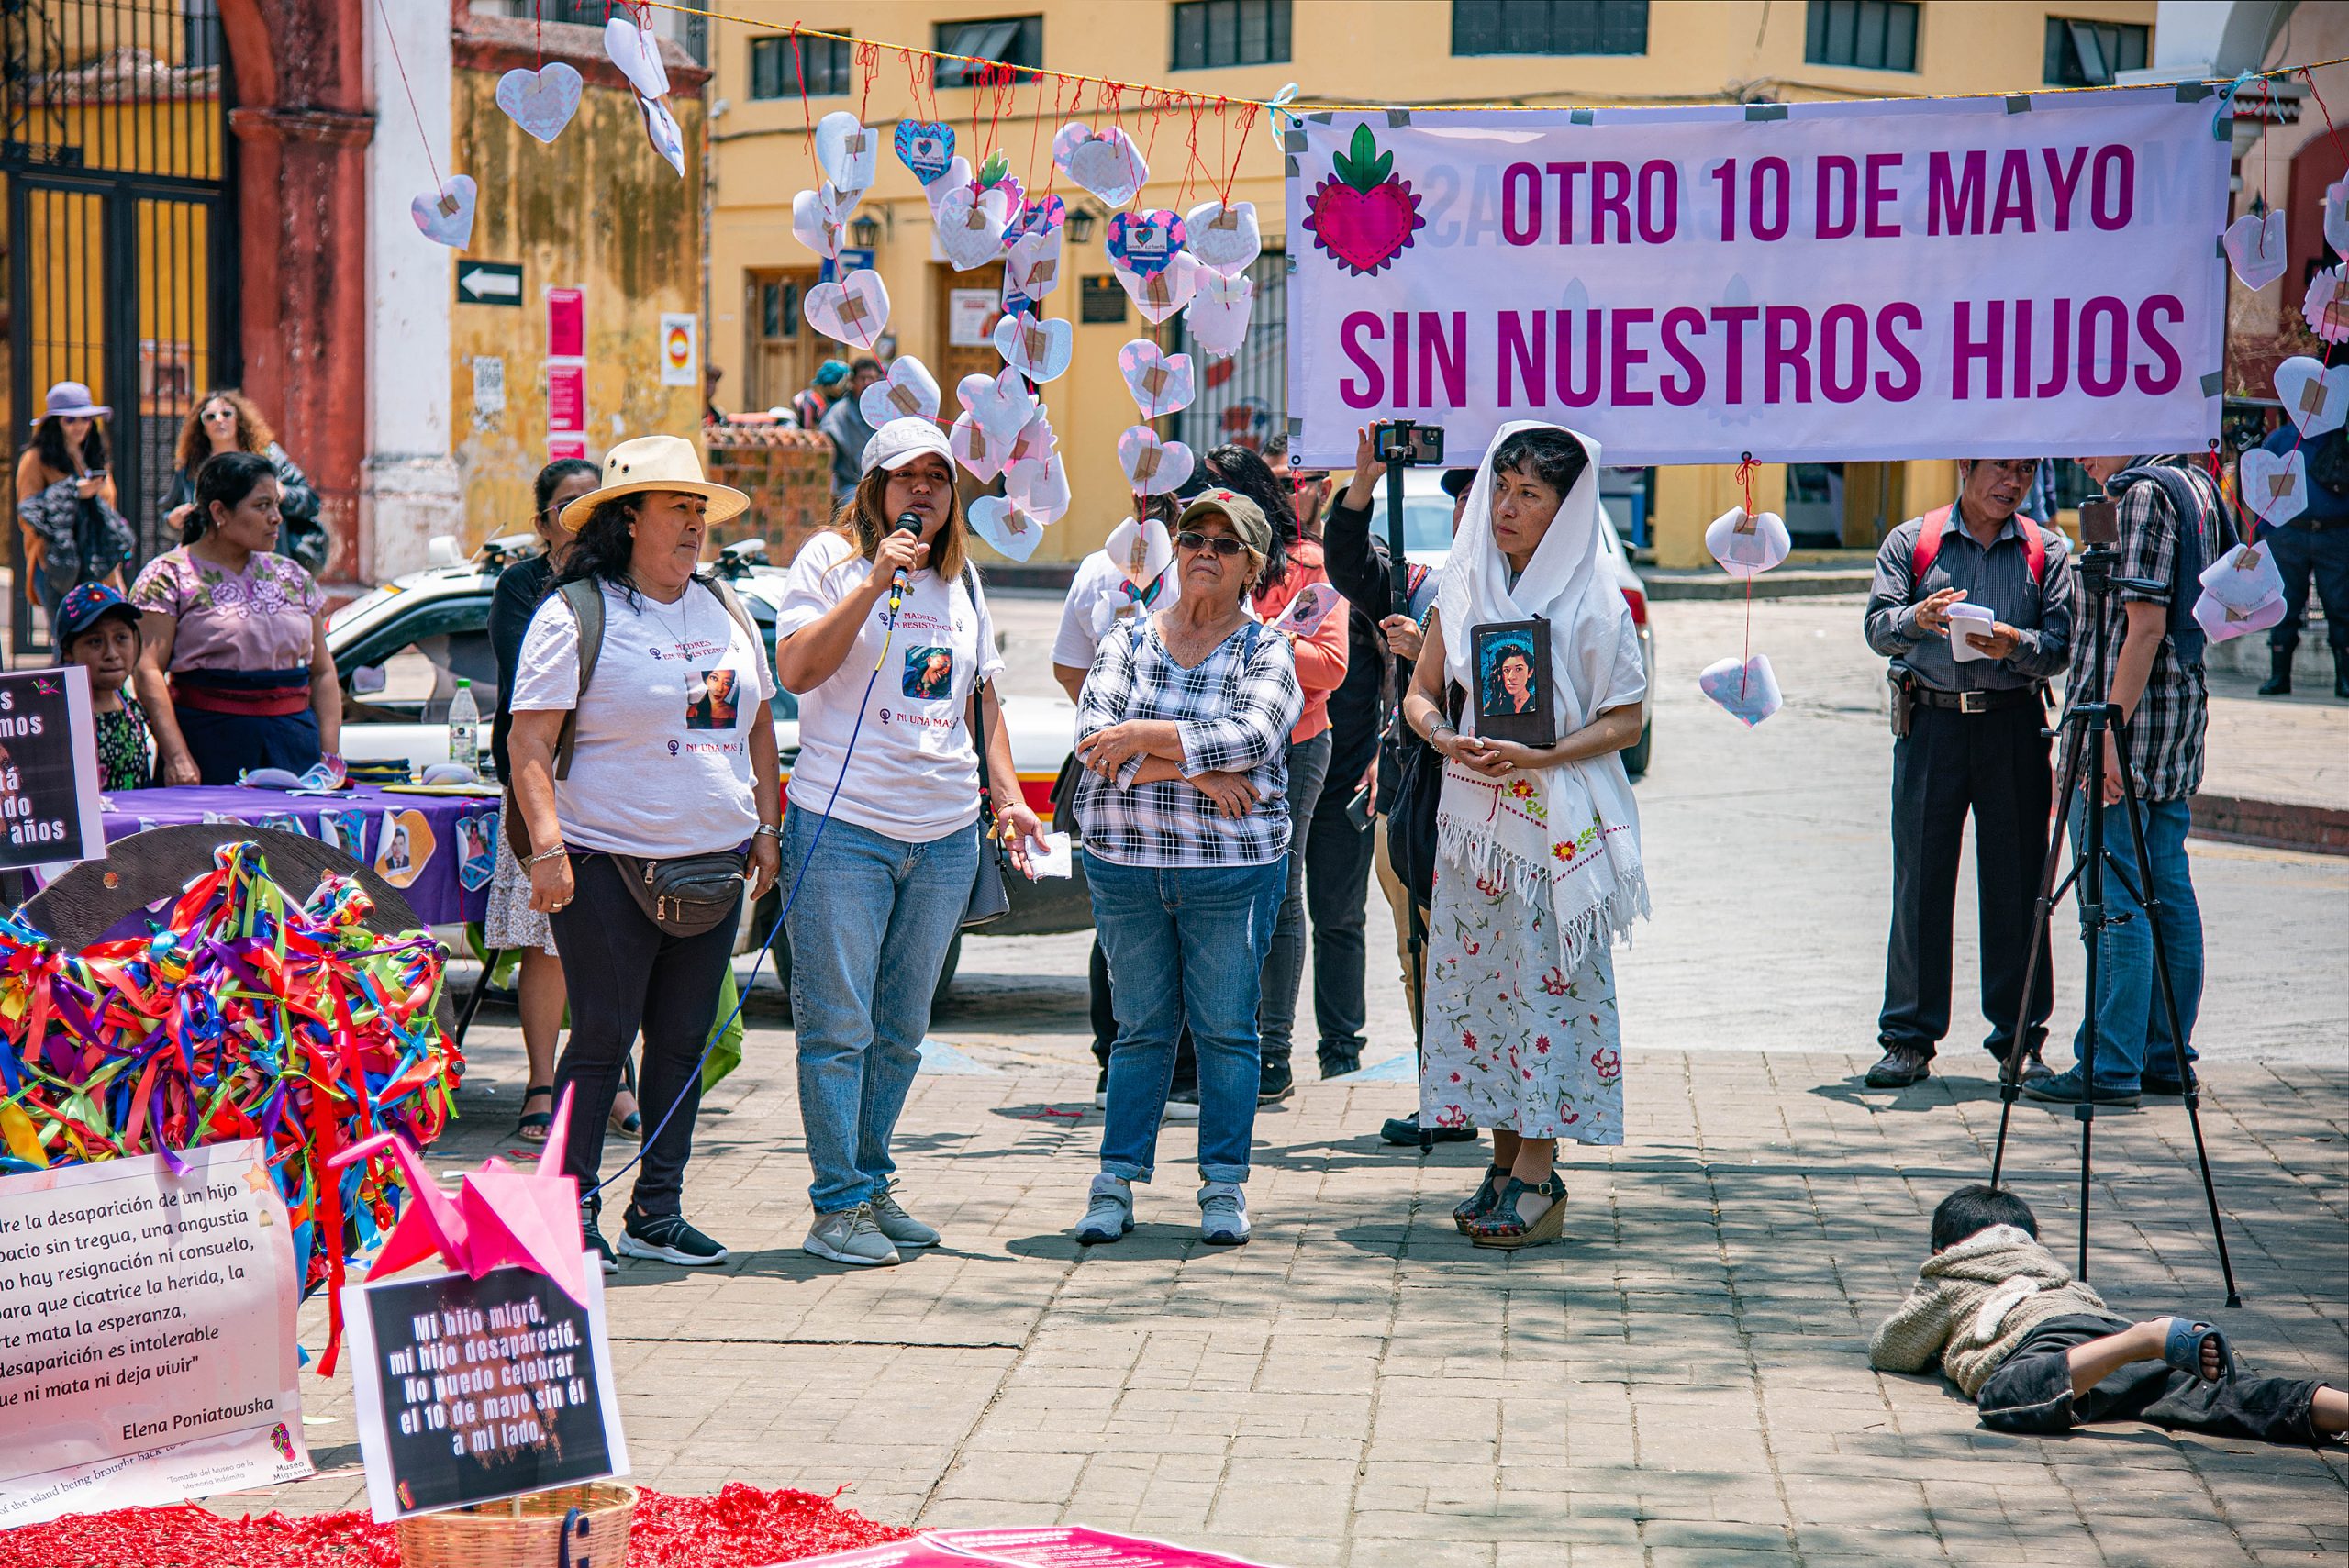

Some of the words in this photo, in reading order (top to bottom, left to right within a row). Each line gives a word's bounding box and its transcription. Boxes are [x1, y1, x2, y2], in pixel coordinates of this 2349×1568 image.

[1501, 158, 1679, 248] OTRO
[1712, 155, 1791, 243] 10
[1815, 153, 1903, 239] DE
[1927, 144, 2135, 237] MAYO
[1339, 309, 1468, 410] SIN
[1497, 301, 1924, 410] NUESTROS
[1951, 294, 2185, 401] HIJOS
[904, 613, 938, 622] MADRES
[910, 716, 930, 726] UNA
[686, 743, 697, 752] NI
[701, 744, 719, 752] UNA
[11, 819, 64, 844] años
[25, 1215, 41, 1229] la
[47, 1198, 153, 1226] desaparición
[158, 1195, 177, 1207] de
[183, 1192, 202, 1204] un
[207, 1185, 237, 1203] hijo
[46, 1239, 69, 1255] sin
[74, 1230, 137, 1251] tregua,
[141, 1224, 173, 1239] una
[178, 1210, 248, 1233] angustia
[19, 1269, 52, 1287] hay
[58, 1253, 152, 1281] resignación
[159, 1251, 173, 1263] ni
[179, 1237, 254, 1261] consuelo,
[37, 1297, 68, 1317] que
[73, 1284, 141, 1307] cicatrice
[147, 1281, 162, 1295] la
[168, 1266, 224, 1291] herida,
[228, 1265, 244, 1280] la
[27, 1327, 71, 1345] mata
[76, 1321, 92, 1336] la
[98, 1306, 186, 1331] esperanza,
[413, 1314, 438, 1341] Mi
[444, 1309, 482, 1337] hijo
[489, 1296, 547, 1329] migró,
[108, 1344, 125, 1357] es
[130, 1327, 219, 1354] intolerable
[389, 1349, 411, 1375] mi
[418, 1342, 457, 1371] hijo
[465, 1320, 582, 1363] desapareció.
[24, 1388, 39, 1402] ni
[45, 1379, 89, 1399] mata
[95, 1373, 110, 1388] ni
[116, 1366, 150, 1386] deja
[156, 1357, 199, 1378] vivir"
[405, 1377, 427, 1403] No
[435, 1368, 495, 1401] puedo
[501, 1353, 573, 1385] celebrar
[122, 1420, 168, 1440] Elena
[173, 1398, 273, 1429] Poniatowska
[401, 1407, 418, 1434] el
[424, 1403, 445, 1430] 10
[452, 1400, 475, 1426] de
[483, 1392, 530, 1420] mayo
[536, 1385, 562, 1411] sin
[569, 1378, 586, 1405] él
[453, 1435, 465, 1456] a
[472, 1429, 495, 1451] mi
[501, 1419, 544, 1448] lado.
[183, 1479, 213, 1490] Memoria
[200, 1468, 211, 1477] del
[212, 1464, 234, 1474] Museo
[273, 1467, 313, 1480] Migrante
[276, 1461, 304, 1472] Museo
[11, 1497, 28, 1510] the
[30, 1485, 60, 1504] island
[61, 1475, 92, 1492] being
